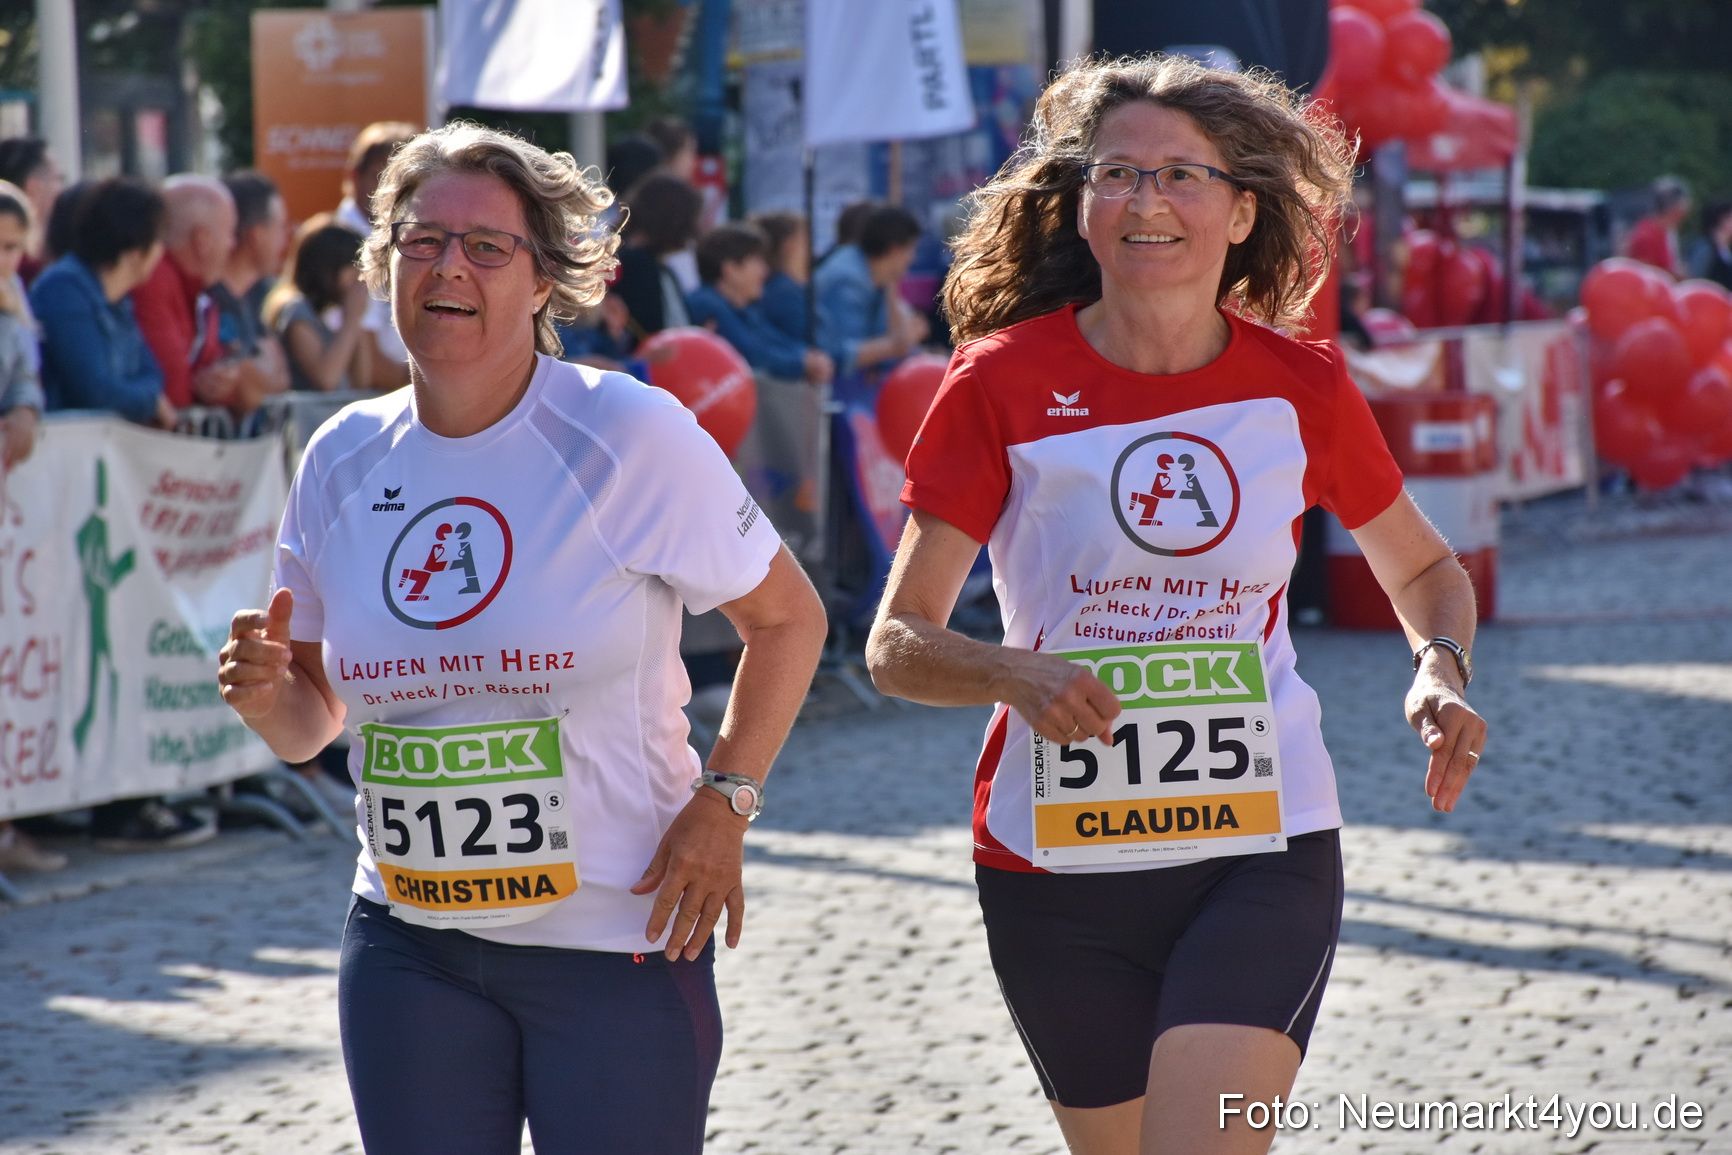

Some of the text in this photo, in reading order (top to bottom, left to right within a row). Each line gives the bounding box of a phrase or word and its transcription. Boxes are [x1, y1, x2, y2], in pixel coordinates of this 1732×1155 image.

[1047, 406, 1089, 417] erima
[372, 501, 405, 512] erima
[1070, 574, 1152, 596] LAUFEN
[1163, 577, 1208, 598] MIT
[1080, 603, 1102, 615] Dr.
[1107, 600, 1150, 618] Heck
[1167, 607, 1190, 620] Dr.
[340, 649, 575, 681] LAUFEN MIT HERZ
[363, 693, 389, 705] Dr.
[390, 685, 437, 702] Heck
[454, 684, 481, 697] Dr.
[485, 682, 550, 695] Röschl
[1255, 720, 1265, 732] S
[371, 727, 548, 780] BOCK
[1059, 717, 1250, 790] 5125
[550, 795, 559, 807] S
[381, 793, 544, 858] 5123
[1075, 804, 1240, 838] CLAUDIA
[394, 874, 558, 904] CHRISTINA
